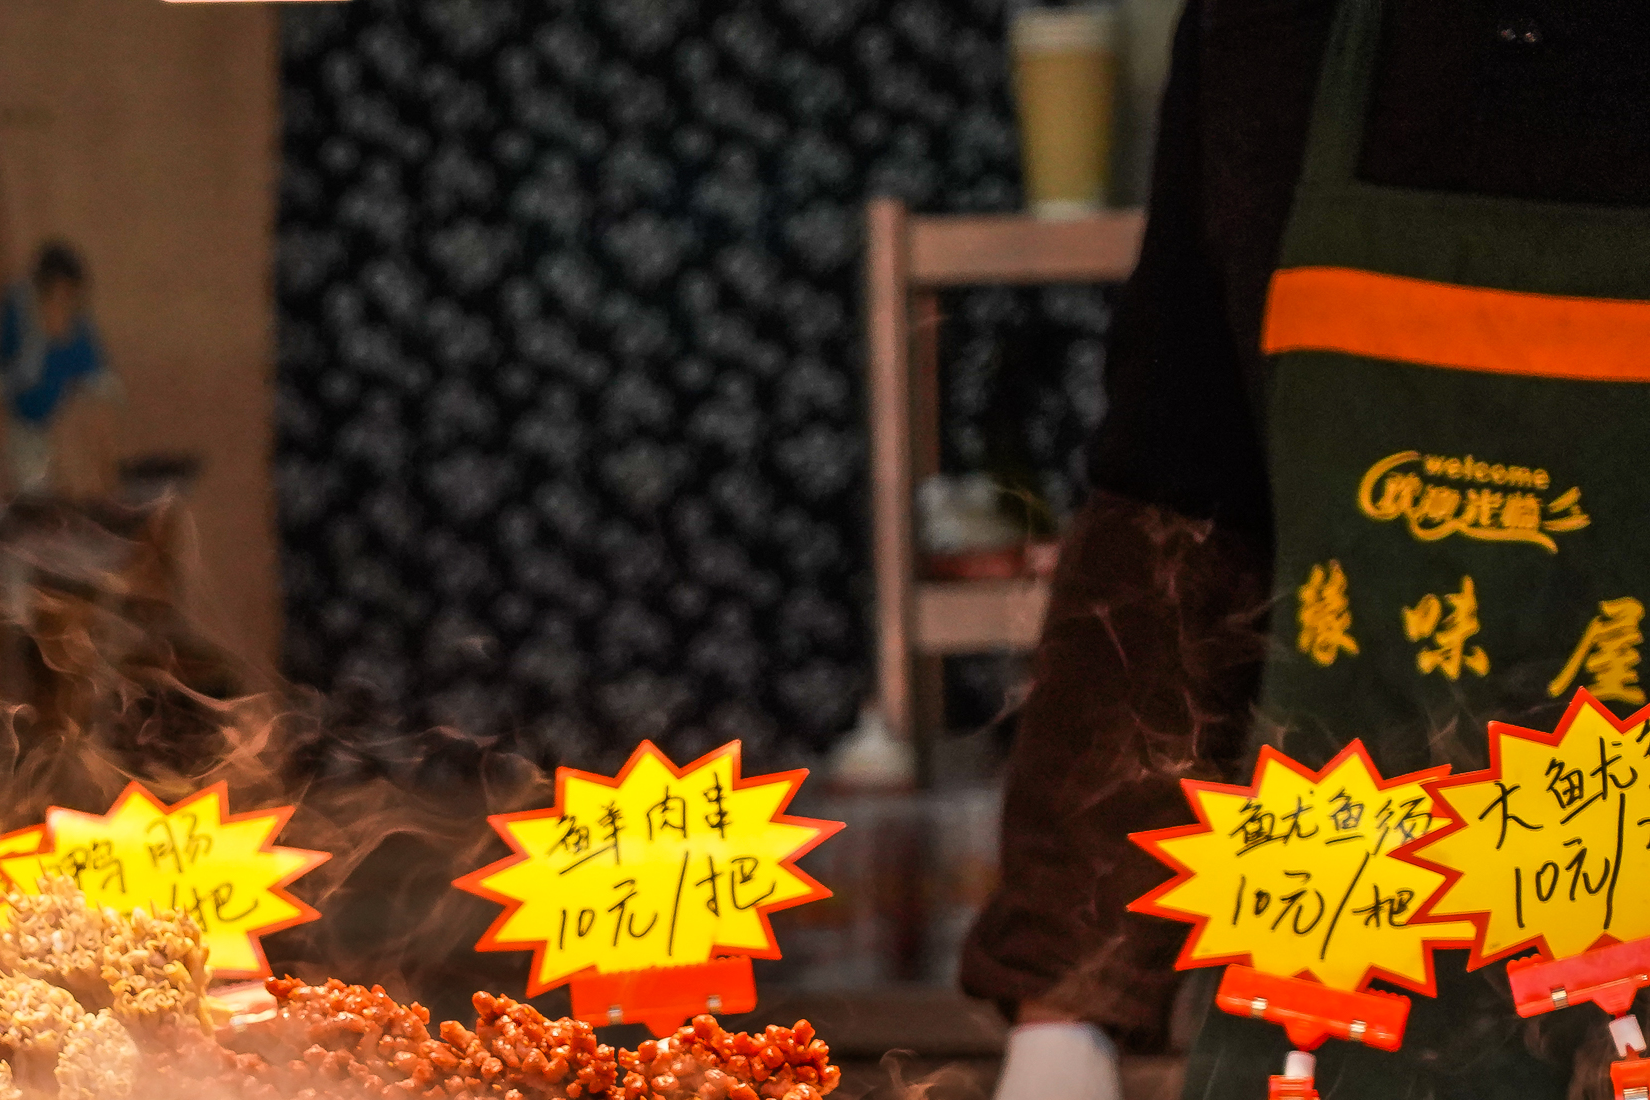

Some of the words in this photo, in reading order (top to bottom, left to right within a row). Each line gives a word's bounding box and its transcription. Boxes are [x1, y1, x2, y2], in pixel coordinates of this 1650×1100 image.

[1425, 454, 1550, 490] welcome
[545, 771, 733, 876] 鲜肉串
[1228, 785, 1433, 858] 鱿鱼须
[1477, 718, 1650, 851] 大鱿
[559, 849, 778, 957] 10元/把
[1513, 790, 1650, 930] 10元/
